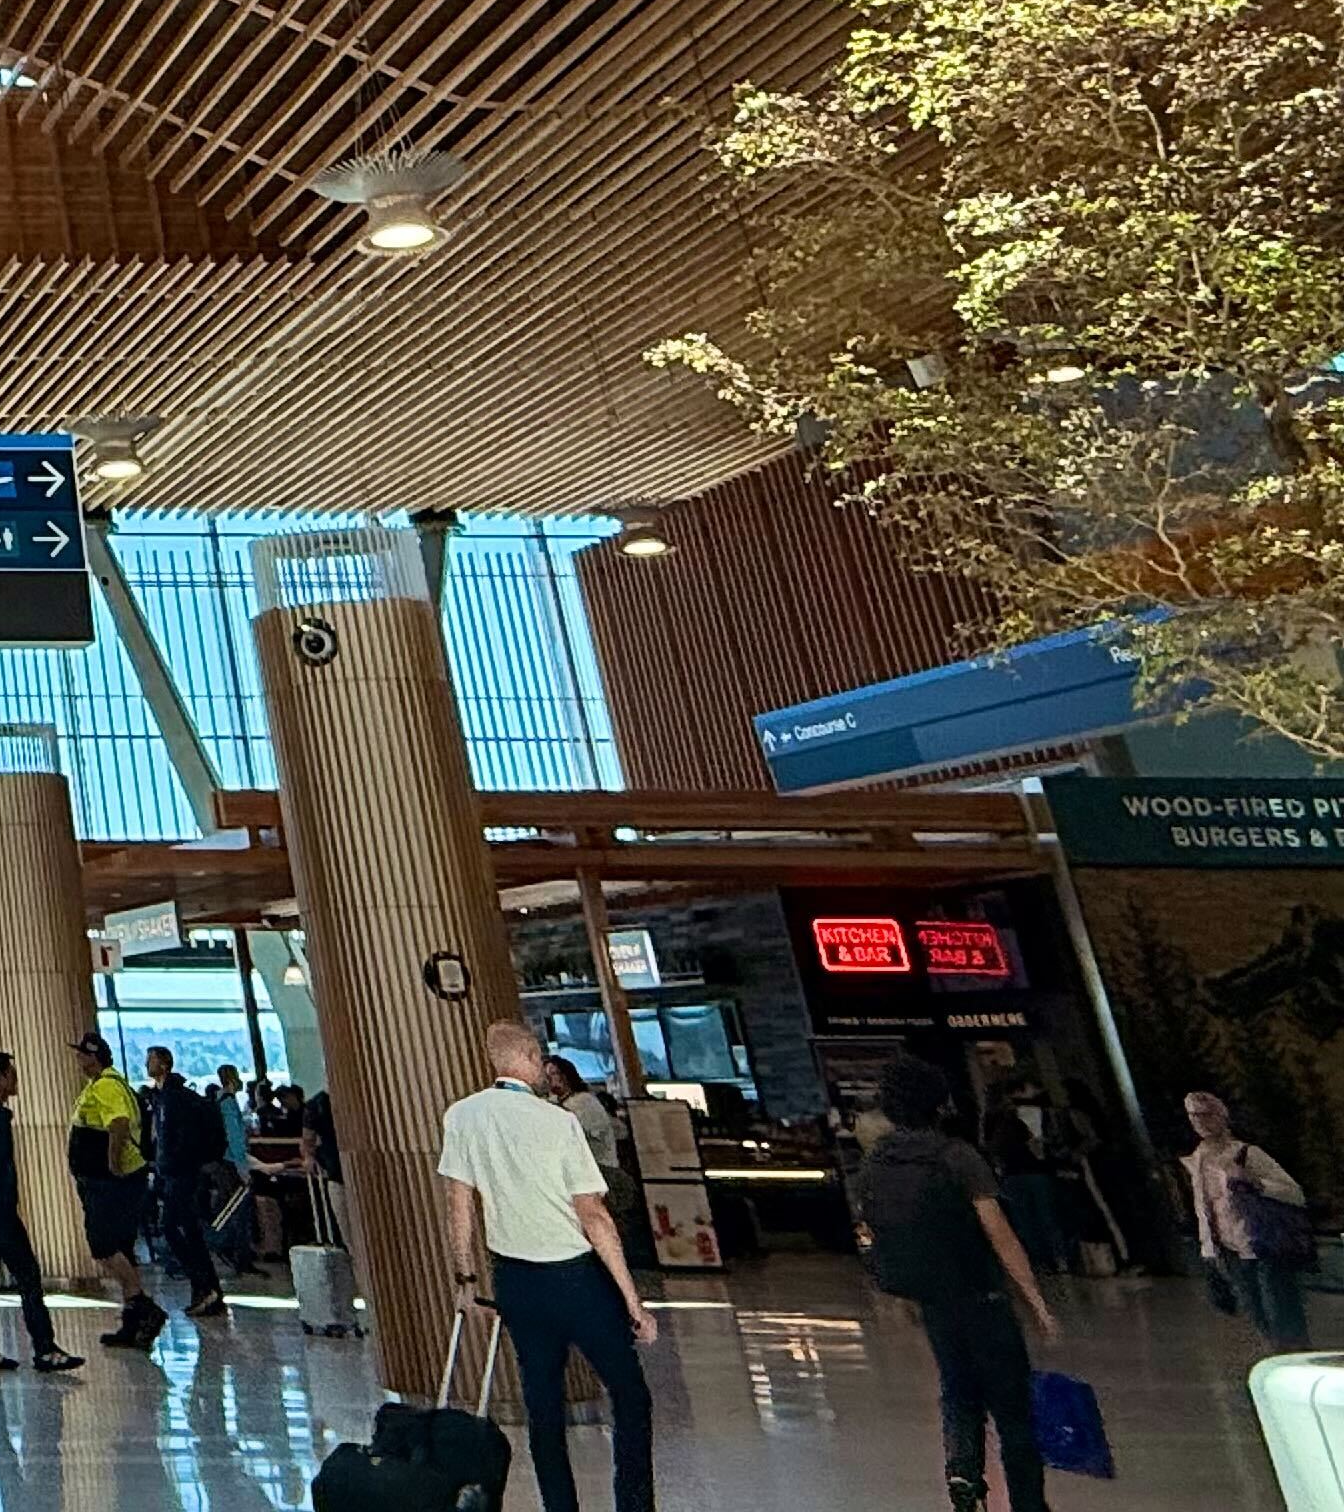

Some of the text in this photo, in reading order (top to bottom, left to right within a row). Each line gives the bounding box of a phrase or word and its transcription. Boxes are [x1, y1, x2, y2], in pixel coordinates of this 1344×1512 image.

[845, 711, 858, 729] C
[1123, 796, 1344, 819] WOOD-FIRED PI
[1170, 826, 1302, 848] BURGERS
[1309, 828, 1329, 848] &
[819, 928, 898, 945] KITCHEN
[854, 947, 892, 962] BAR
